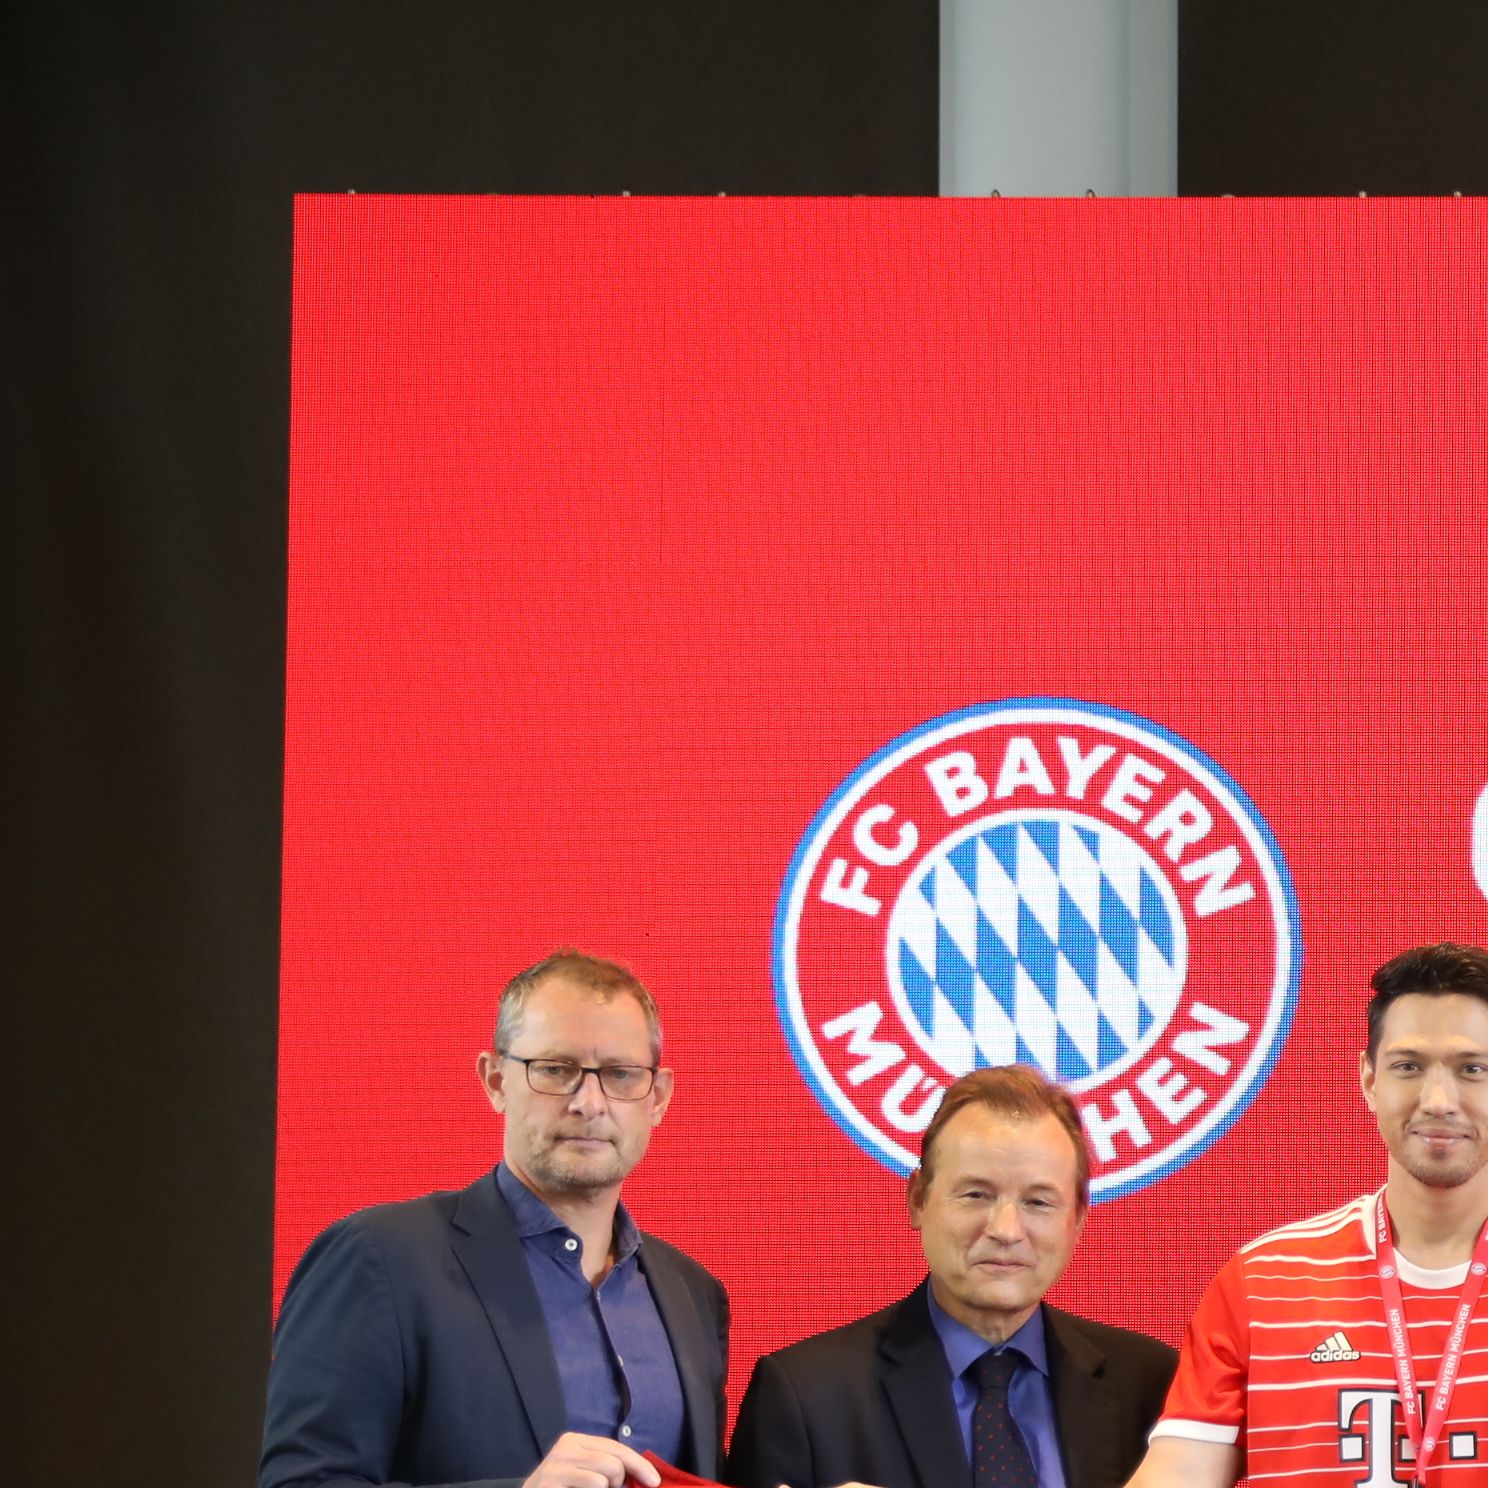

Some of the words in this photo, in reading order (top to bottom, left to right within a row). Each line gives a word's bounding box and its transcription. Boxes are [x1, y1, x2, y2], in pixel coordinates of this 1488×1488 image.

[820, 803, 919, 917] FC
[923, 735, 1256, 917] BAYERN
[822, 1000, 1251, 1163] MÜHEN
[1389, 1308, 1409, 1359] MÜNCHEN
[1449, 1303, 1471, 1356] MÜNCHEN
[1310, 1349, 1361, 1363] adidas
[1438, 1357, 1457, 1397] BAYERN
[1398, 1359, 1414, 1399] BAYERN
[1435, 1397, 1446, 1411] FC
